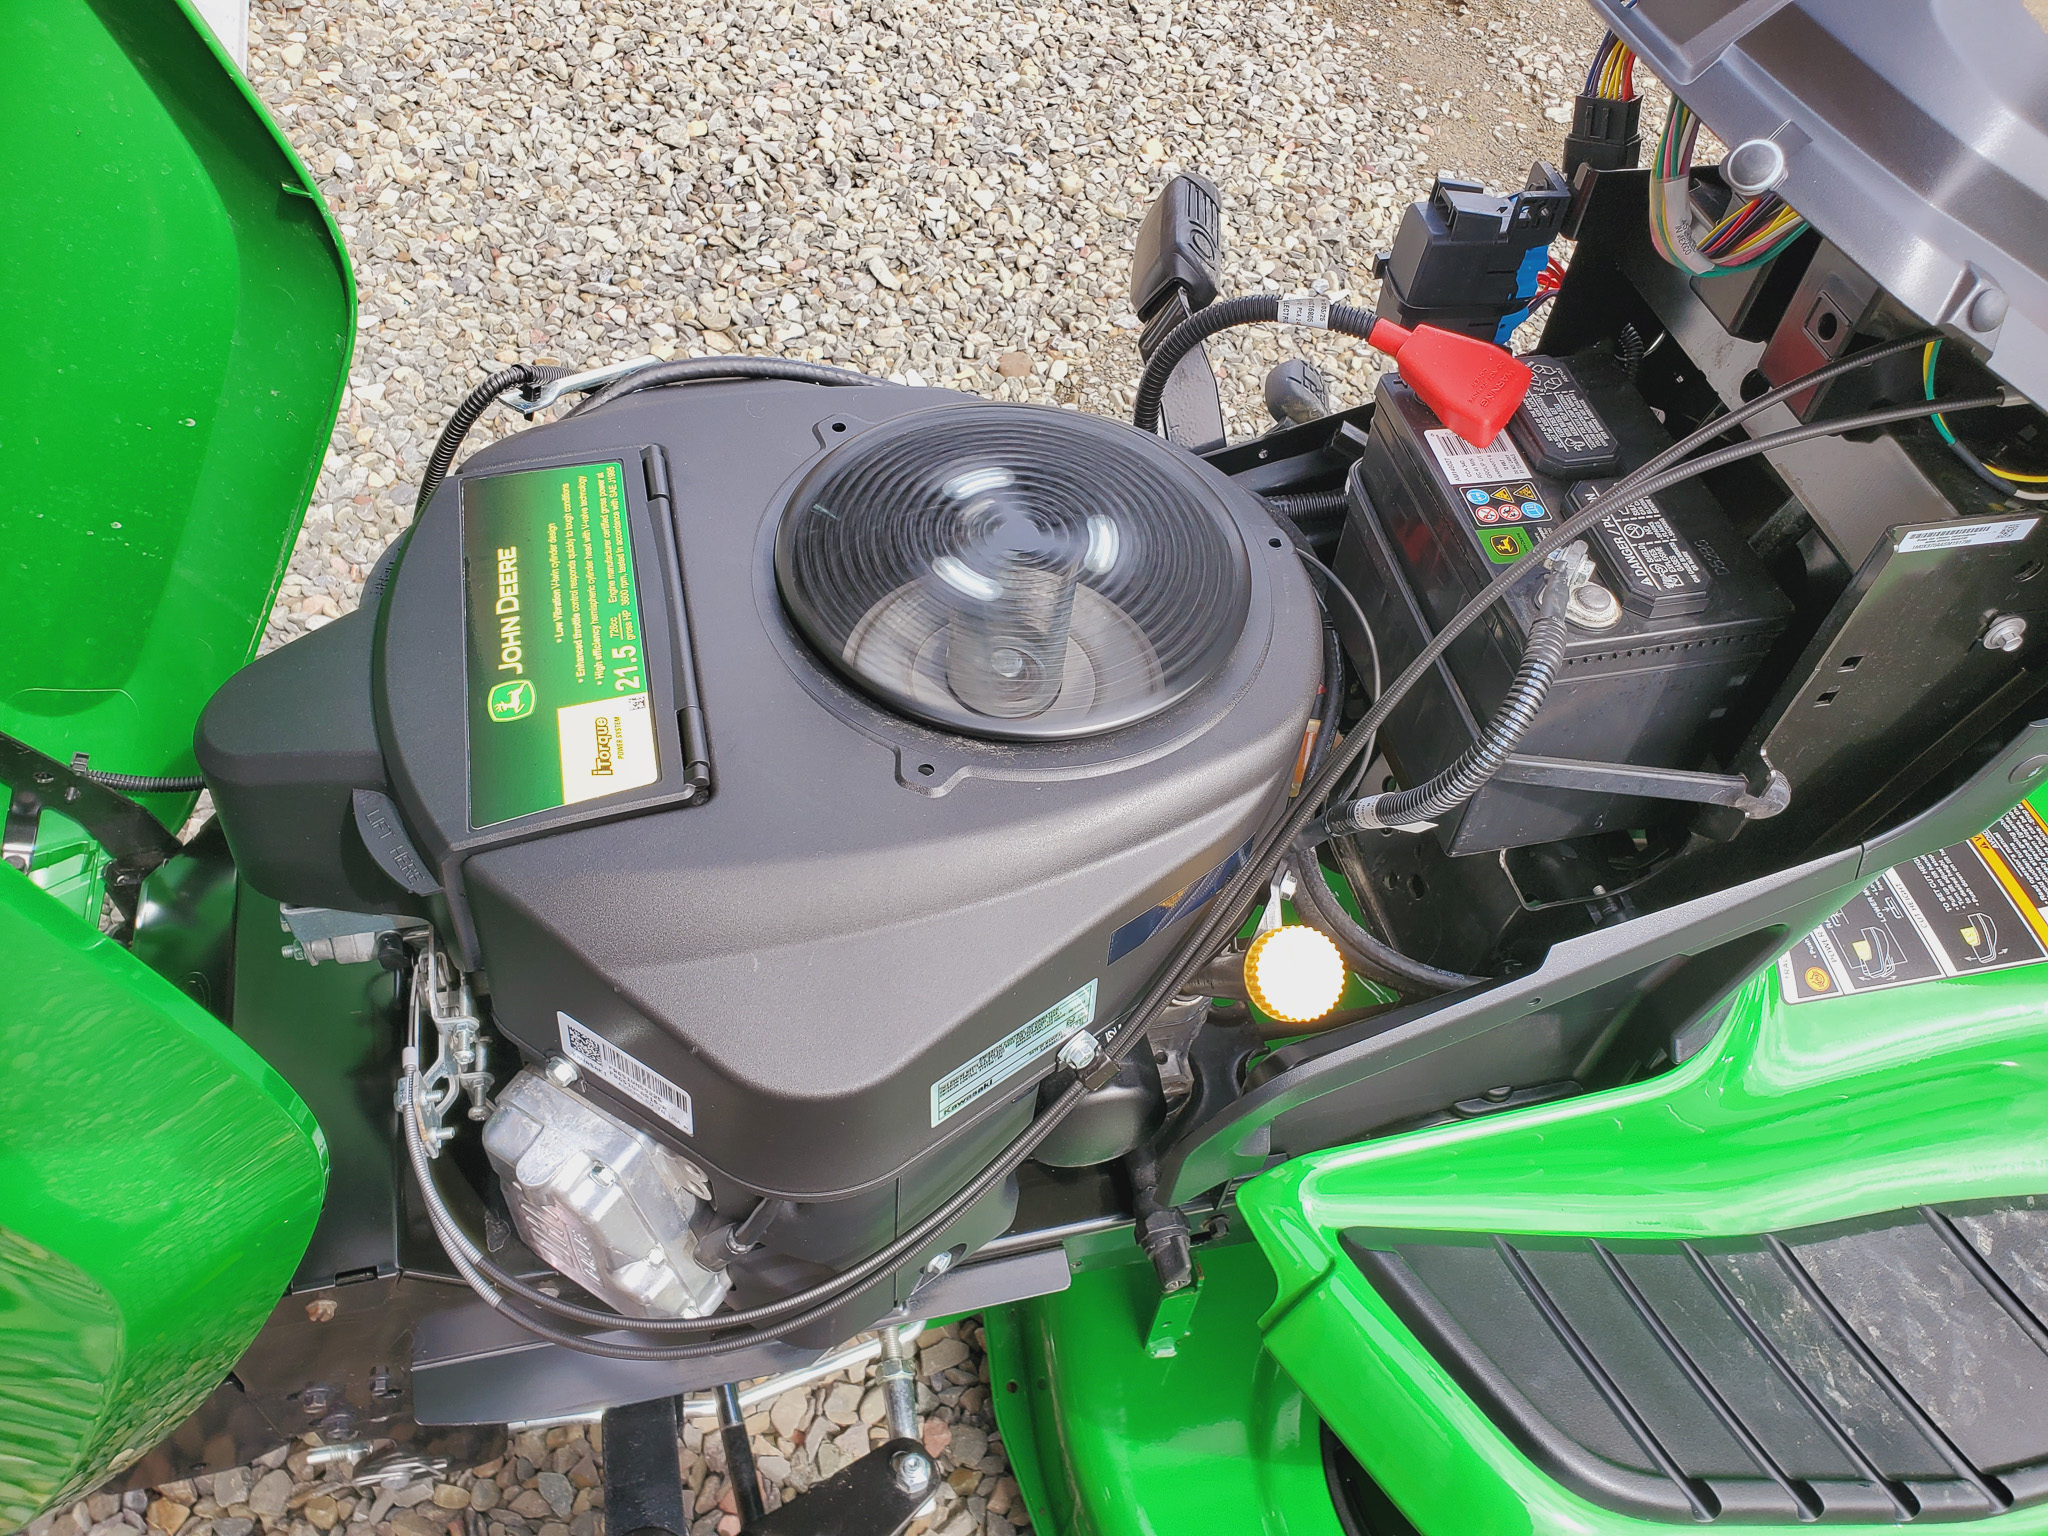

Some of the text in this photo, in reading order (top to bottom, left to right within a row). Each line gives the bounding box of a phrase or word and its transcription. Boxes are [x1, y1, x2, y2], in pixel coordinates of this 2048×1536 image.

[1677, 235, 1691, 255] MEXICO
[1489, 370, 1497, 380] NOT
[1480, 370, 1515, 407] WARNING
[562, 483, 571, 512] conditions
[598, 479, 607, 496] power
[608, 484, 618, 498] SAE
[600, 497, 609, 514] gross
[610, 498, 619, 510] with
[563, 513, 574, 529] tough
[600, 514, 610, 538] certified
[613, 511, 623, 545] accordance
[1643, 526, 1653, 534] NO
[565, 538, 577, 559] quickly
[604, 539, 615, 579] manufacturer
[1613, 537, 1647, 577] DANGER
[1648, 549, 1661, 561] EYES
[1654, 546, 1677, 572] EXPLOSIVE
[616, 553, 626, 573] tested
[1669, 555, 1684, 571] GASES
[547, 523, 564, 637] Low Vibration V-twin cylinder design
[567, 560, 579, 589] responds
[577, 476, 606, 679] High efficiency hemispheric cylinder head with V-valve technology
[619, 573, 629, 588] rpm,
[569, 590, 579, 612] control
[607, 580, 618, 603] Engine
[620, 589, 630, 606] 3600
[495, 546, 523, 675] JOHN DEERE
[571, 613, 582, 639] throttle
[609, 617, 619, 638] 726cc
[622, 610, 635, 640] gross HP
[573, 639, 585, 677] Enhanced
[611, 645, 640, 691] 21.5
[591, 716, 613, 776] iTorque
[613, 716, 625, 760] POWER SYSTEM
[365, 809, 426, 885] LIFT HERE
[2009, 832, 2037, 866] stops going
[2010, 842, 2023, 858] turns
[2022, 839, 2041, 861] devices
[1928, 854, 1939, 866] stop
[1938, 859, 1953, 876] height
[1993, 832, 2047, 900] Read operator's manual
[2022, 859, 2040, 881] sudden
[1924, 875, 1937, 888] CUT
[1931, 870, 1939, 878] lift
[1935, 867, 1950, 883] adjust
[1955, 872, 1968, 887] down
[1933, 889, 1946, 901] SET
[1950, 877, 1967, 896] desired
[1966, 888, 1978, 902] Push
[1943, 902, 1952, 911] TO
[1947, 895, 1958, 906] Pull
[1954, 892, 1964, 904] Turn
[1867, 897, 1887, 922] LOWER
[1805, 938, 1816, 954] Push
[943, 1077, 992, 1116] Kawasaki
